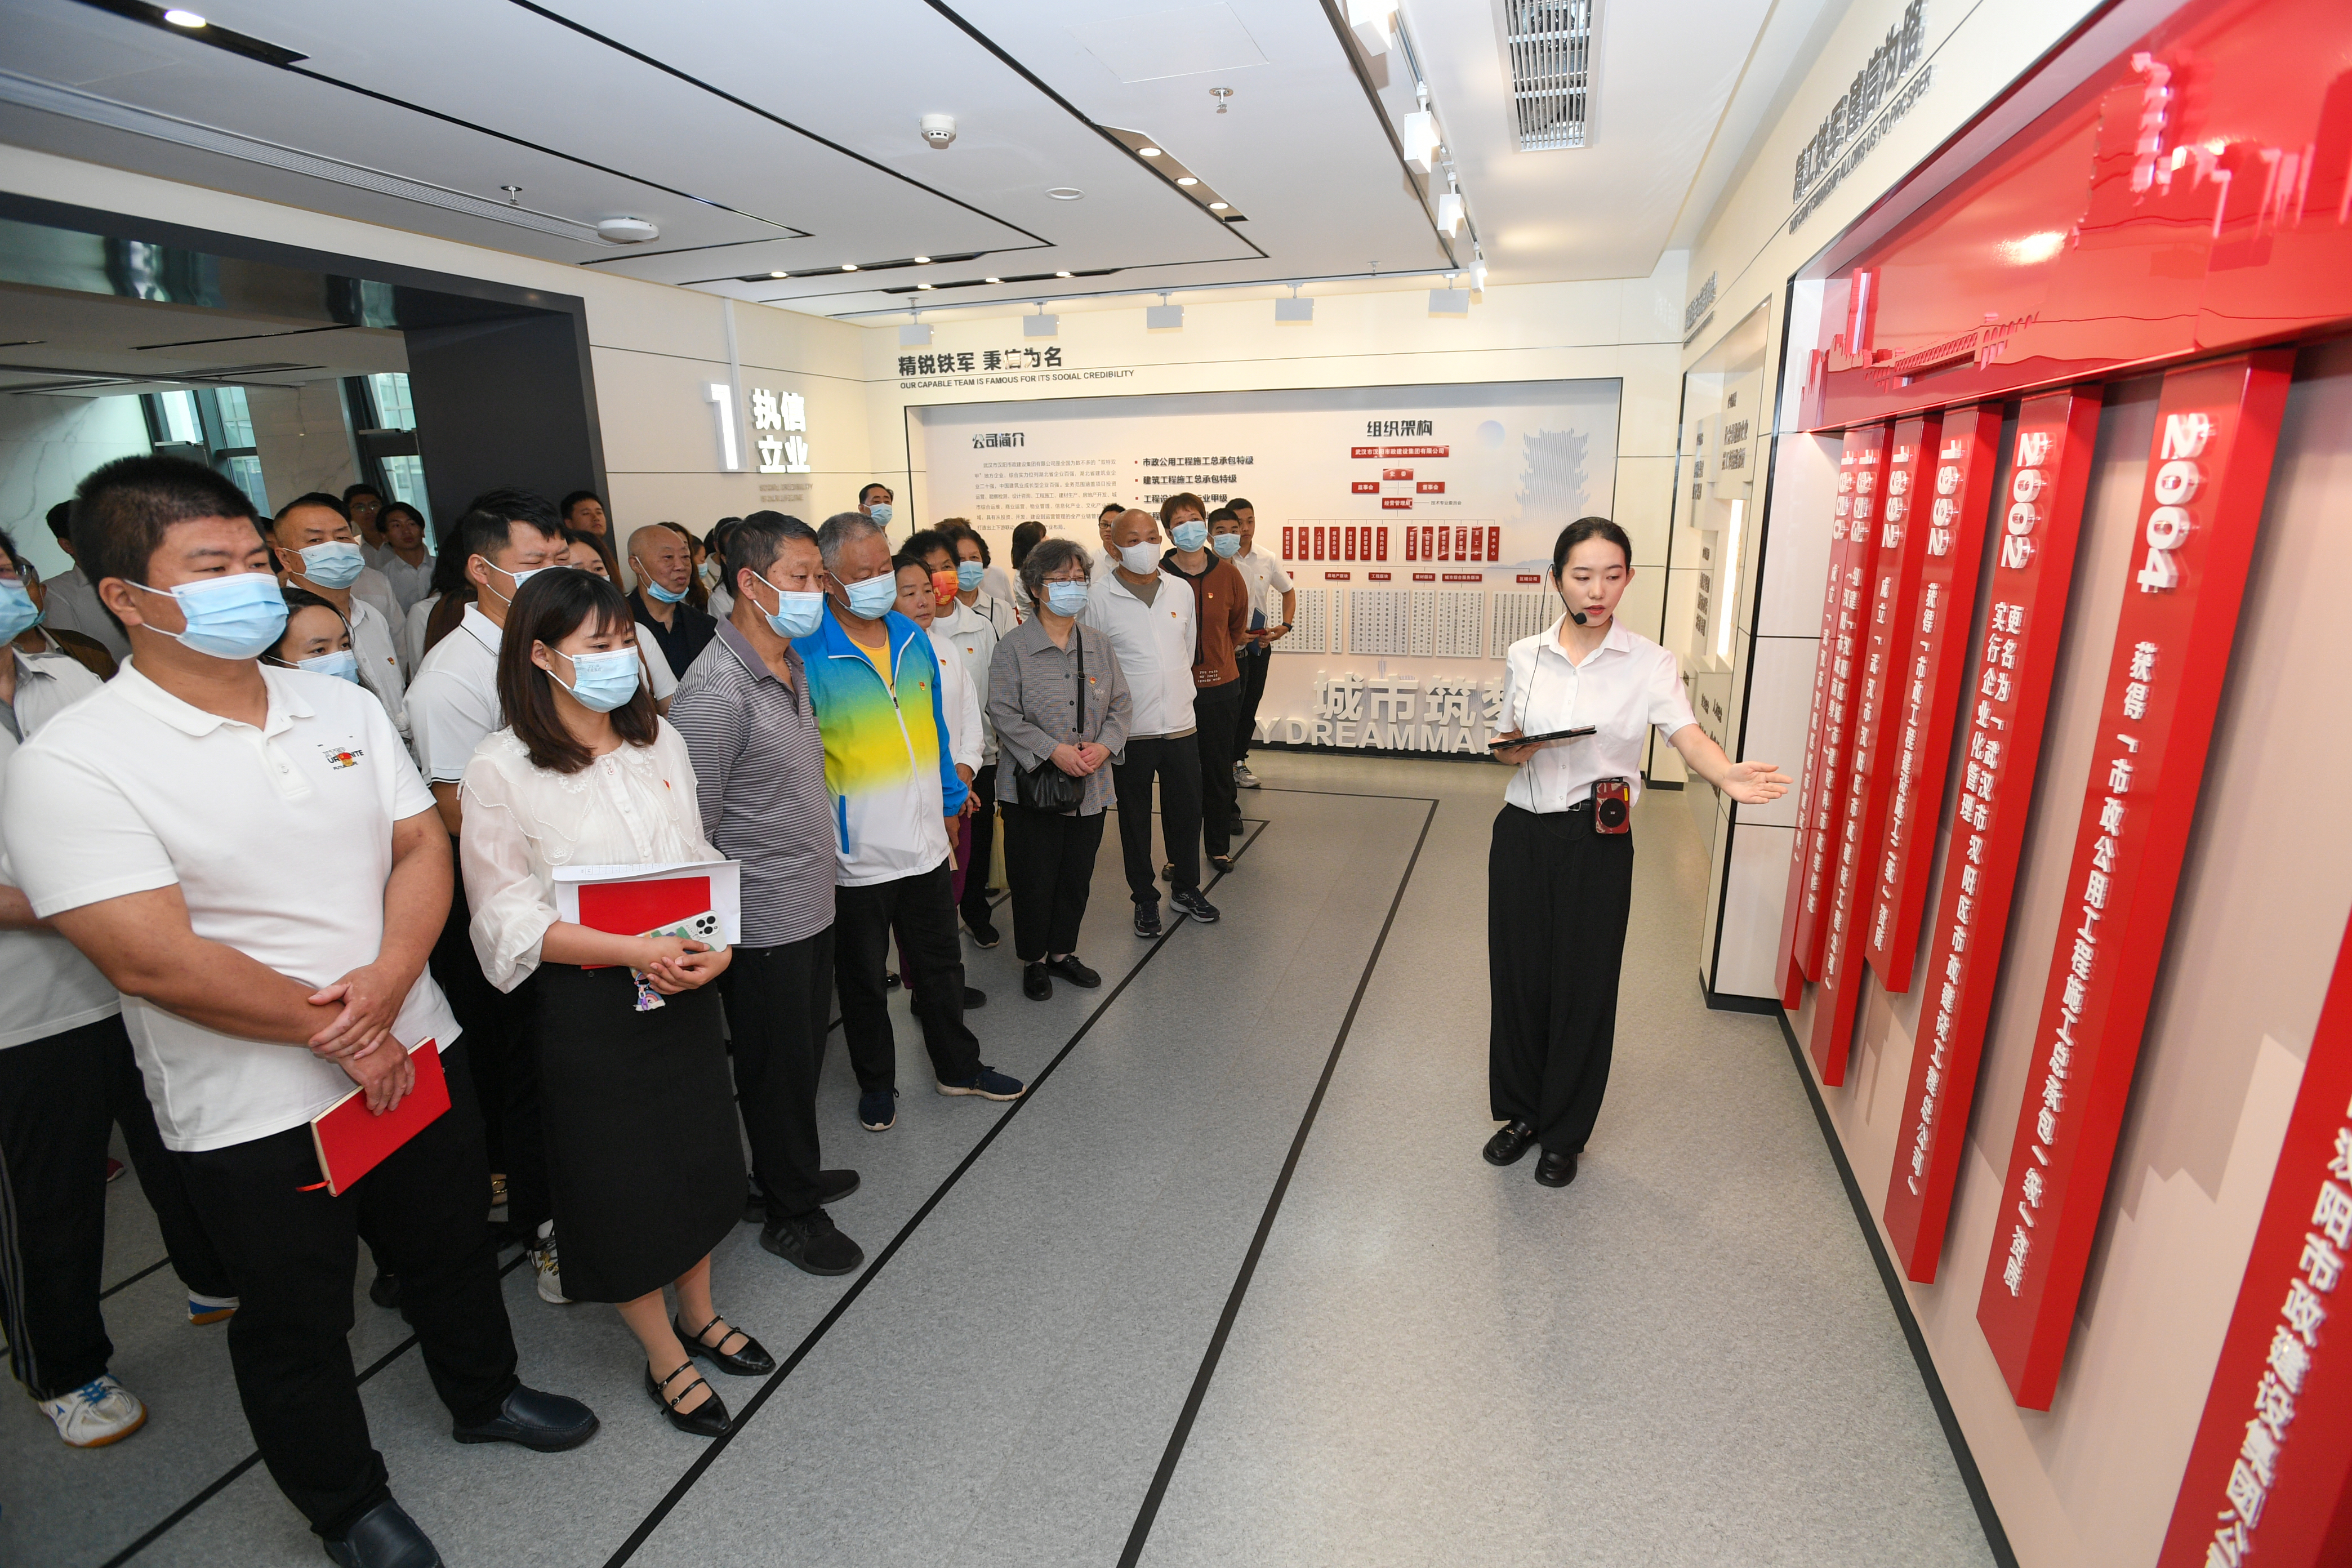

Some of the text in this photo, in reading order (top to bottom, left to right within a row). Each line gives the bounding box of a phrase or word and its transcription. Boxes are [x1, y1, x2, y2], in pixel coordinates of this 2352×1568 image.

[1867, 126, 1877, 152] US
[1878, 113, 1889, 140] TO
[898, 346, 1062, 377] 精锐铁军 秉信为名
[900, 380, 916, 389] OUR
[917, 379, 952, 389] CAPABLE
[954, 378, 975, 386] TEAM
[985, 376, 1018, 385] FAMOUS
[1083, 369, 1134, 380] CREDIBILITY
[752, 387, 806, 432] 执信
[1366, 420, 1433, 436] 组织架构
[758, 434, 810, 474] 立业
[972, 432, 1025, 449] 公司简介
[1142, 456, 1254, 467] 市政公用工程施工总承包特级
[1142, 474, 1237, 485] 建筑工程施工总承包特级
[1833, 450, 1857, 540] 1950
[1882, 445, 1914, 549] 1992
[1927, 439, 1967, 556] 1992
[2001, 431, 2047, 569] 2002
[2137, 412, 2212, 594] 2004
[1959, 602, 2010, 823] 实行企业化管理
[322, 746, 346, 758] XTEP
